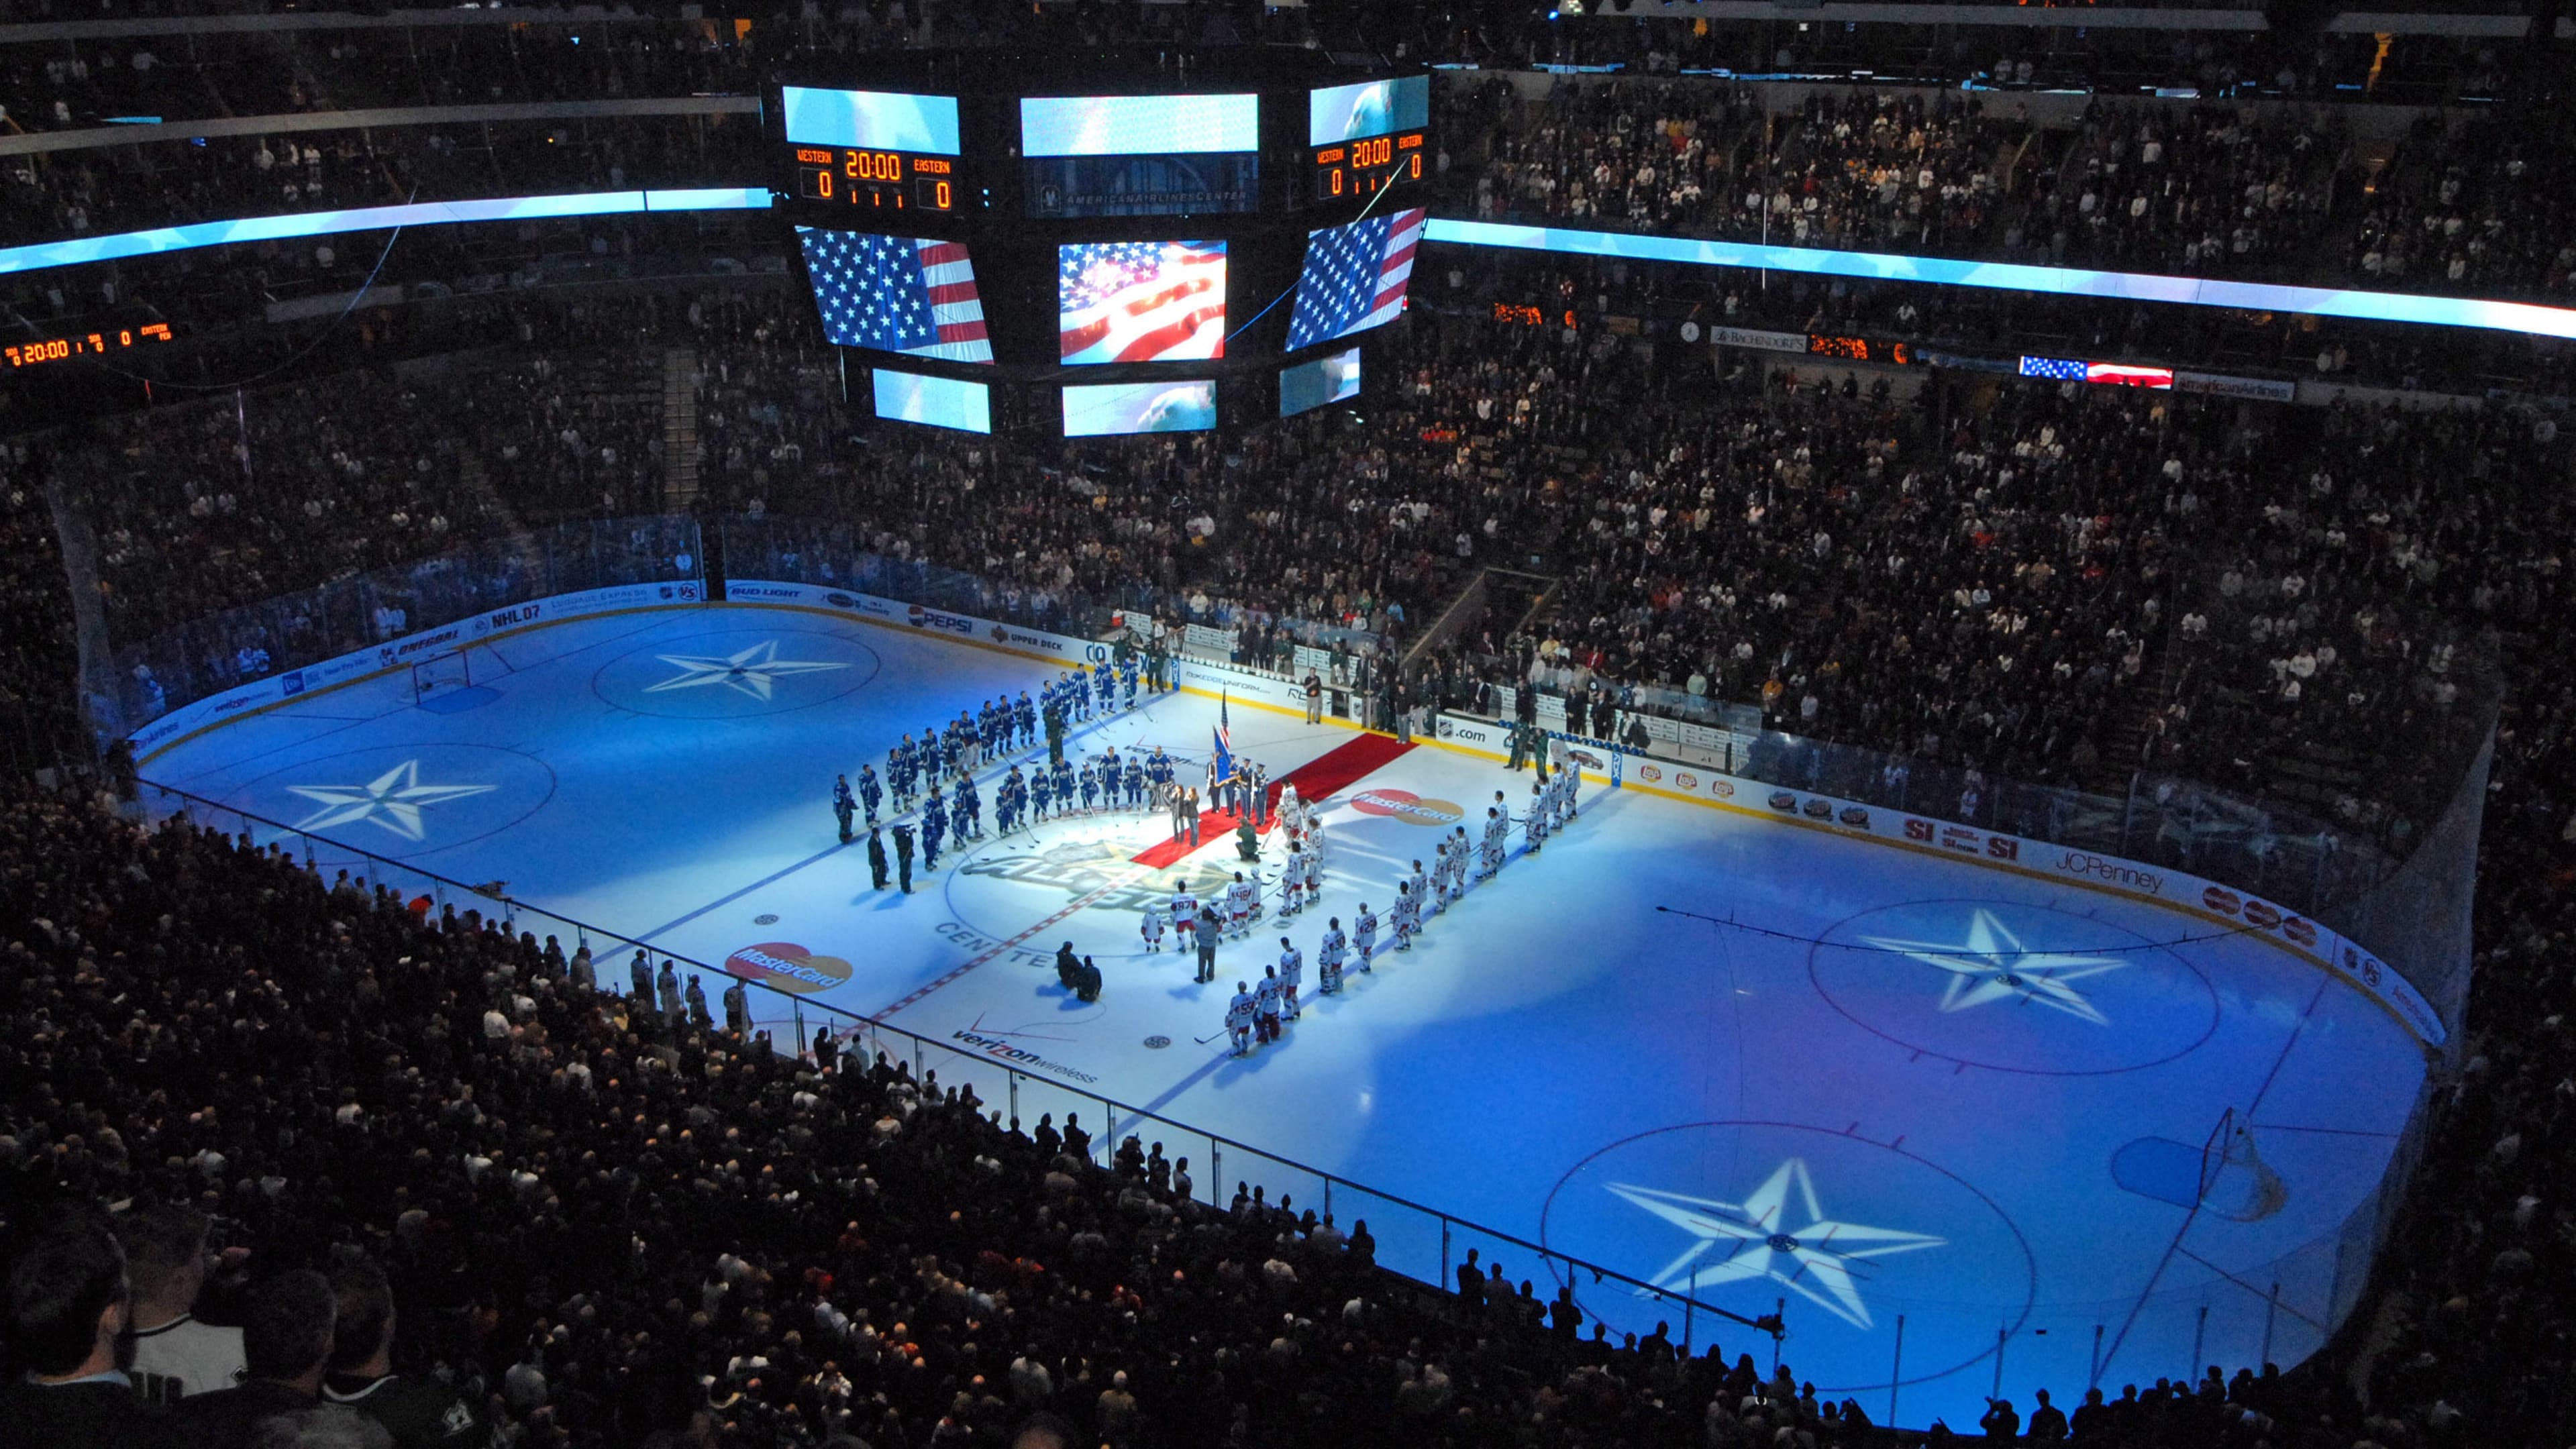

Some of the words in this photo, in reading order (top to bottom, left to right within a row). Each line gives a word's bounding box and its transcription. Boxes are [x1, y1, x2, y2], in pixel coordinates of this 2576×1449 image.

[797, 150, 832, 164] WESTERN
[1353, 138, 1390, 168] 20:00
[846, 152, 900, 180] 20:00
[914, 160, 951, 174] EASTERN
[1411, 154, 1421, 179] 0
[819, 171, 832, 197] 0
[1332, 168, 1342, 195] 0
[936, 181, 950, 209] 0
[121, 331, 131, 345] 0
[24, 340, 68, 363] 20:00
[731, 587, 760, 596] BUD
[763, 588, 801, 598] LIGHT
[492, 611, 522, 629] NHL
[523, 604, 540, 620] 07
[924, 612, 972, 633] PEPSI
[1011, 633, 1038, 645] UPPER
[1041, 639, 1062, 651] DECK
[1455, 729, 1486, 743] .com
[1353, 792, 1461, 822] MasterCard
[1906, 819, 1934, 842] SI
[1988, 837, 2018, 861] SI
[2057, 851, 2163, 894] JCPenney
[1177, 900, 1191, 911] 87
[935, 922, 1058, 969] CENTE
[733, 948, 845, 987] MasterCard
